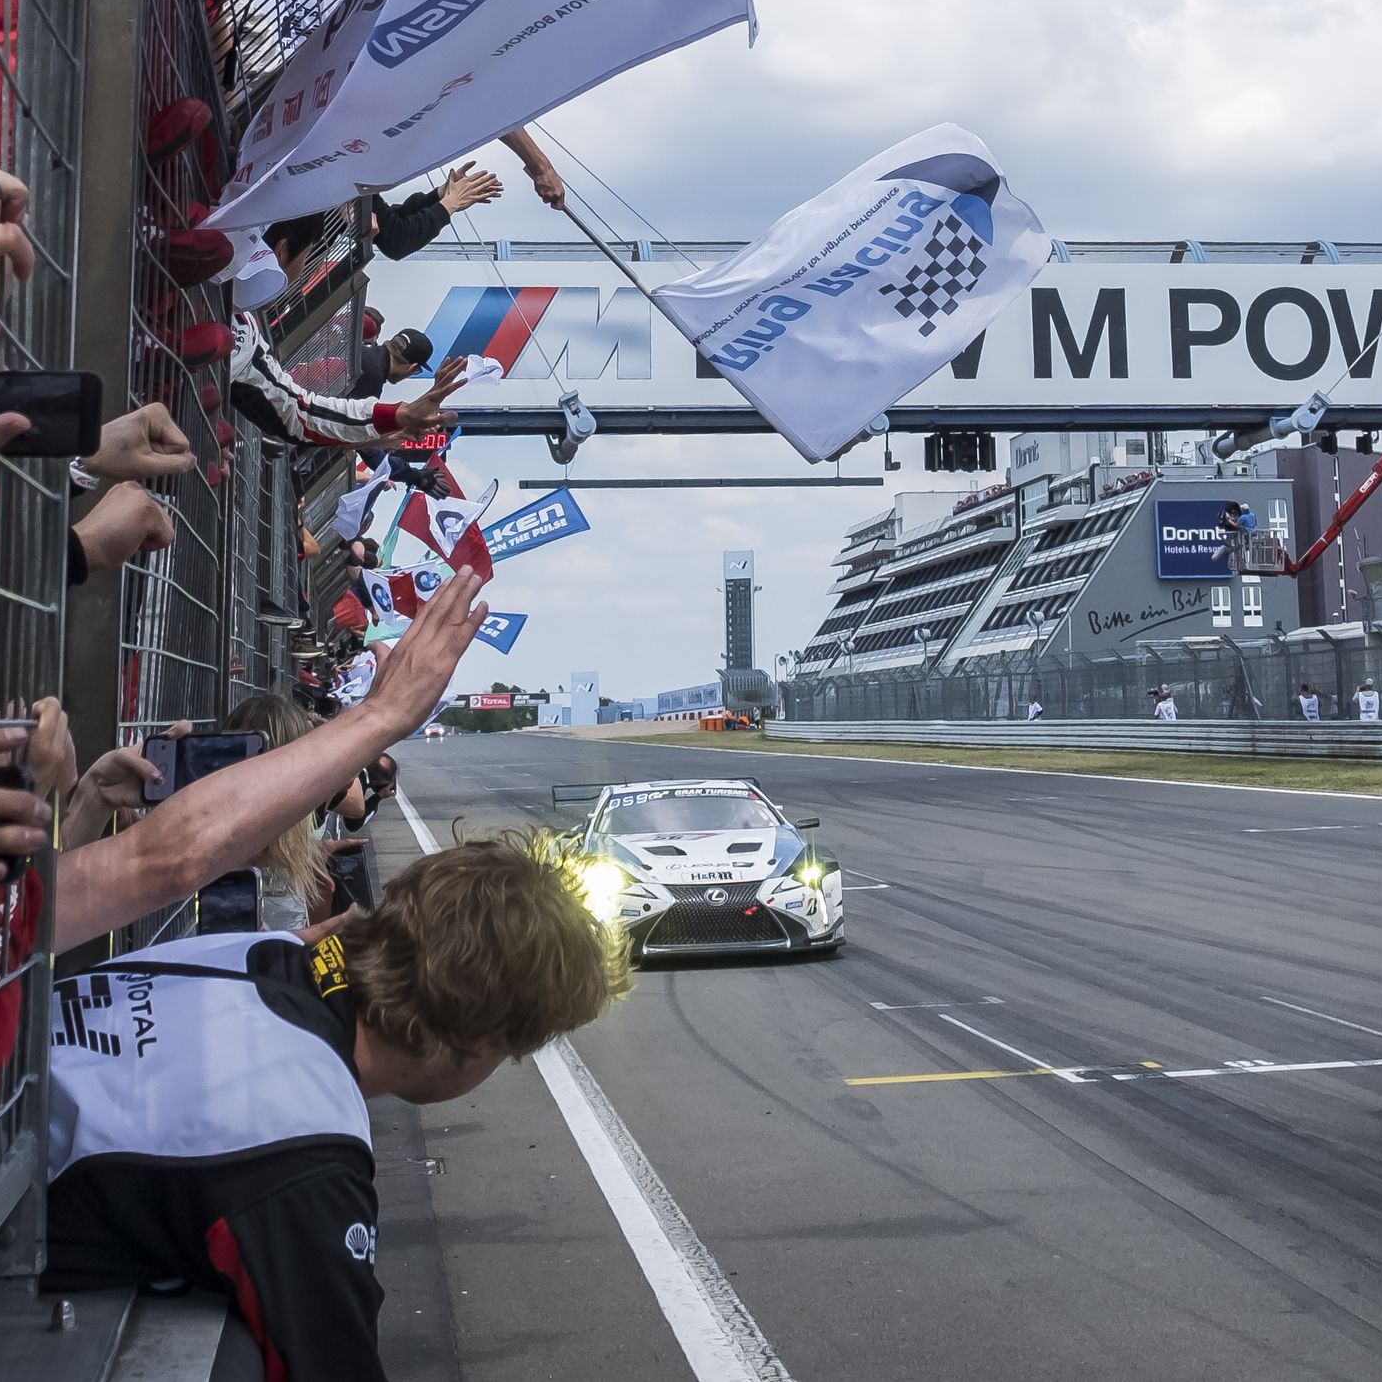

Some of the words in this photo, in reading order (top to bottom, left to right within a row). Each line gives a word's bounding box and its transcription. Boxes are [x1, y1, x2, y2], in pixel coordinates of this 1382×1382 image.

[1031, 288, 1129, 380] M
[489, 542, 506, 555] ON
[508, 532, 531, 547] THE
[532, 519, 567, 538] PULSE
[1164, 545, 1190, 554] Hotels
[1088, 609, 1133, 635] Bitte
[1140, 605, 1168, 620] ein
[1173, 588, 1208, 612] Bit
[481, 698, 509, 706] TOTAL
[674, 788, 703, 797] GRAN
[705, 788, 749, 797] TURISMO
